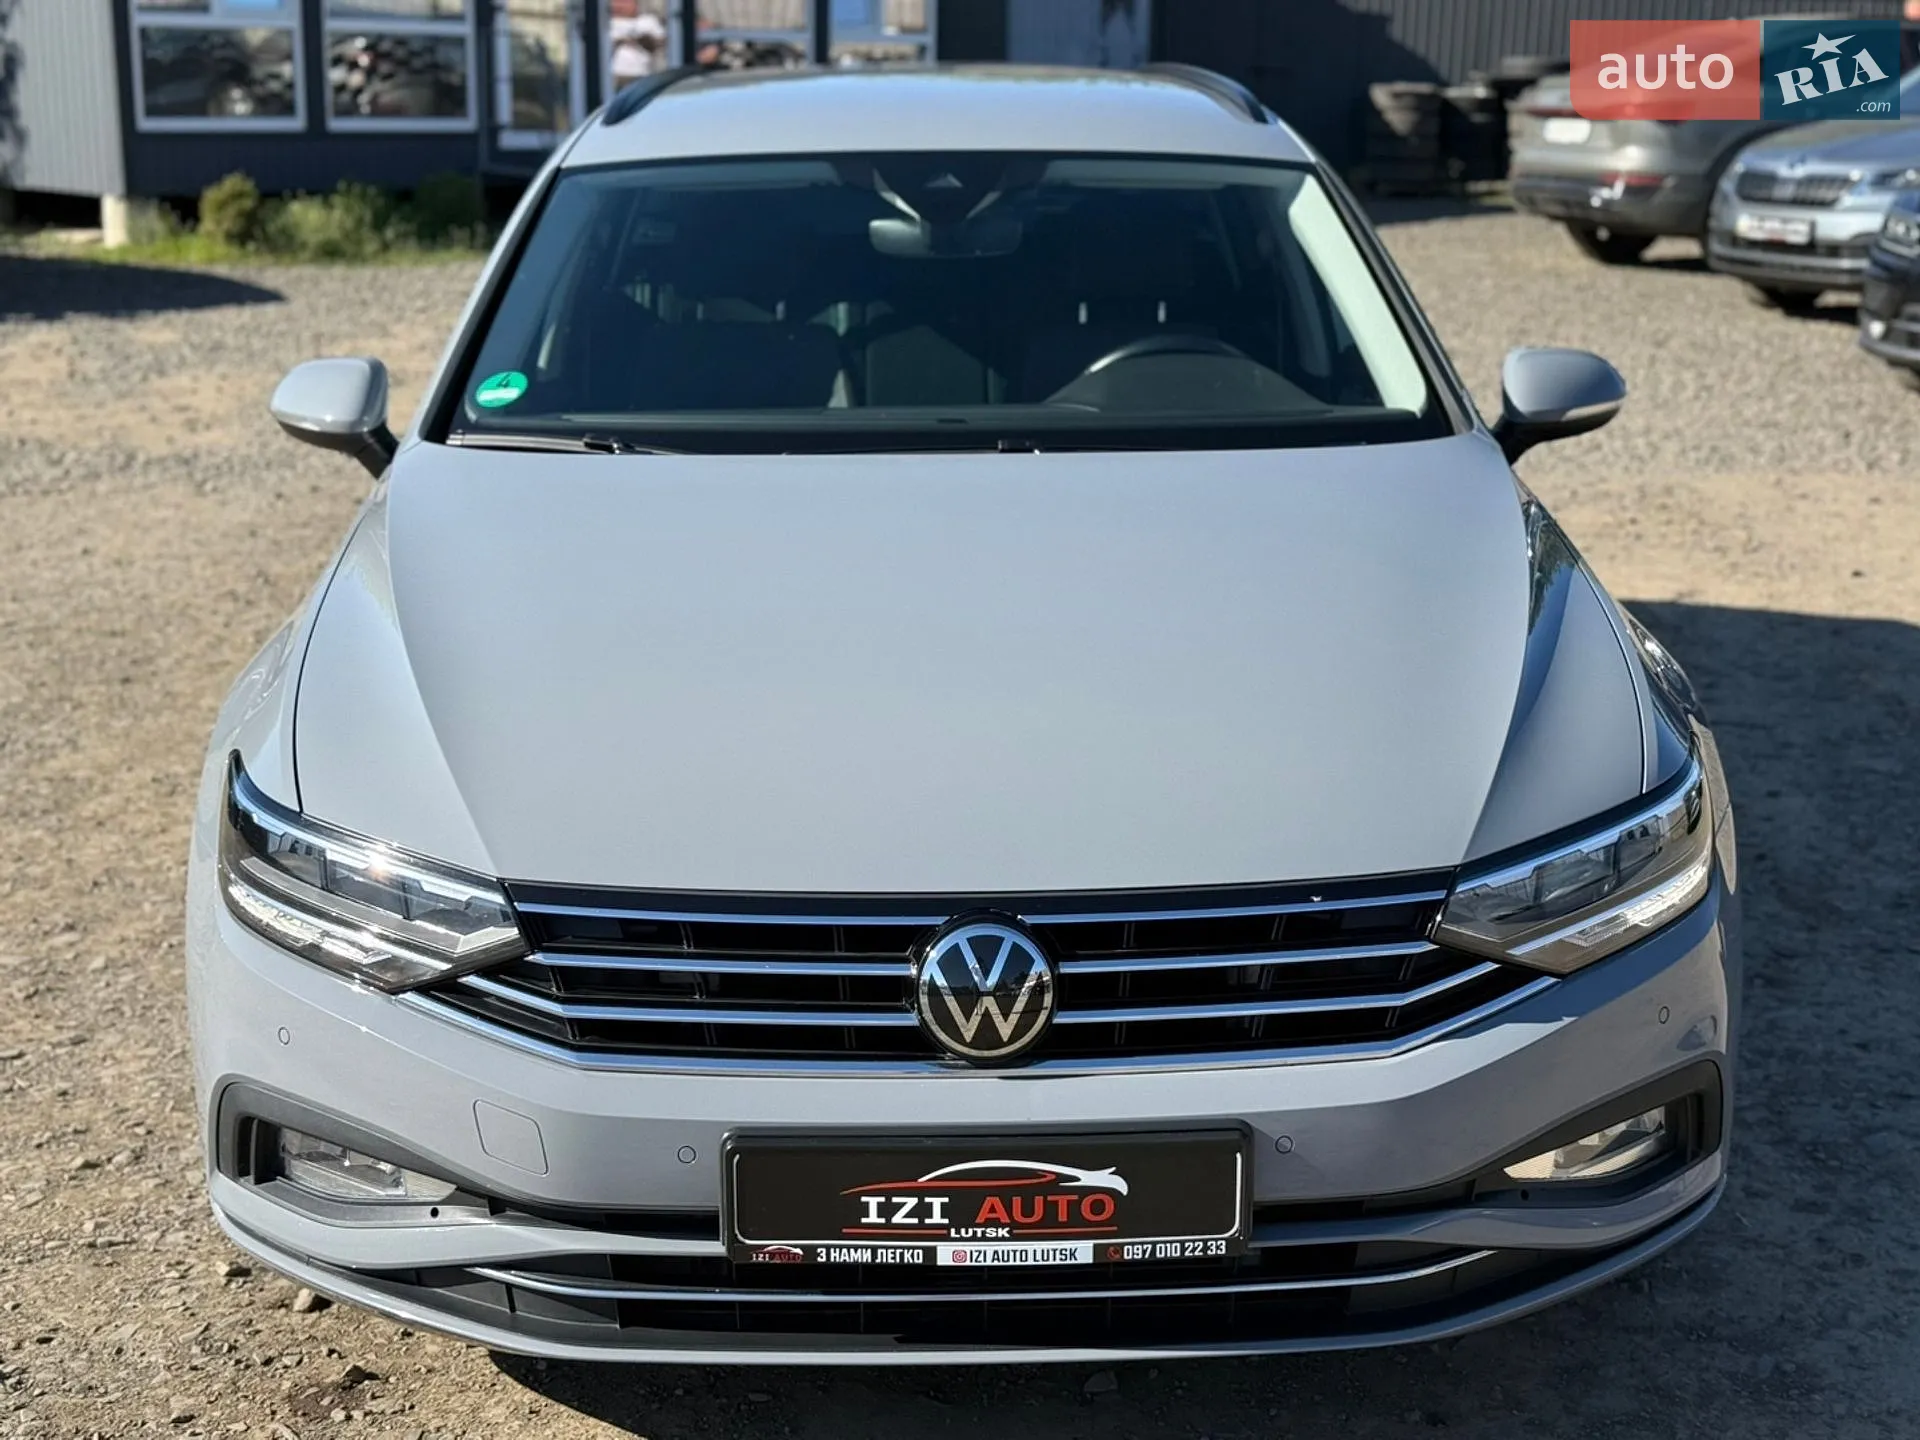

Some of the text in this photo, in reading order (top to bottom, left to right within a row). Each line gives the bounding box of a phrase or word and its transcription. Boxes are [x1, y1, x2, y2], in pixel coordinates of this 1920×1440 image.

[860, 1193, 1116, 1225] IZI AUTO
[950, 1227, 1011, 1238] LUTSK
[752, 1253, 769, 1261] IZI
[816, 1248, 923, 1264] З НАМИ ЛЕГКО
[969, 1247, 1078, 1263] IZI AUTO LUTSK
[1123, 1240, 1226, 1259] 097 010 22 33
